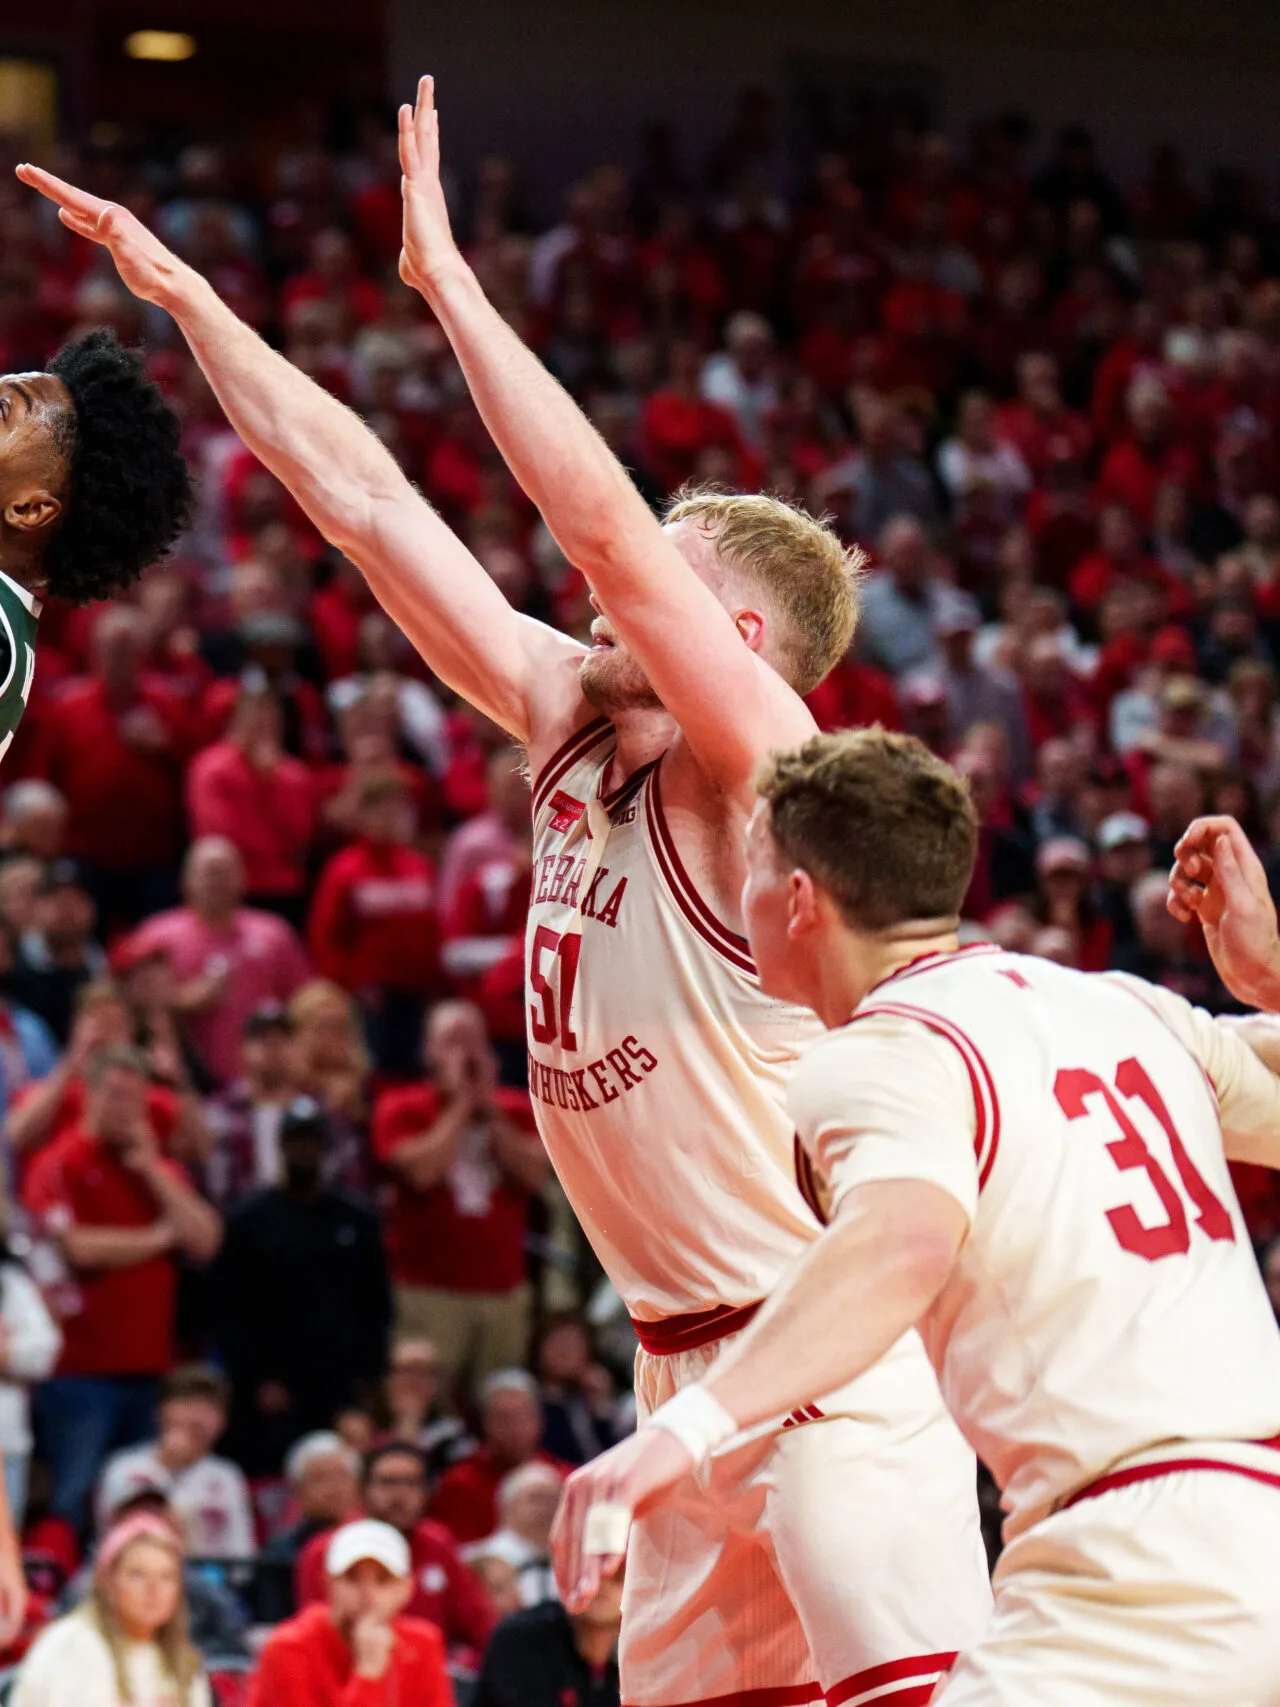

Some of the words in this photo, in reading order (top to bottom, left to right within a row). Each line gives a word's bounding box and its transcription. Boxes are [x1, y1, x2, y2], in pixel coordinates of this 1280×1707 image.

[552, 818, 569, 830] x2
[529, 854, 629, 928] EBRAKA
[530, 924, 583, 1051] 51
[1053, 1056, 1236, 1262] 31
